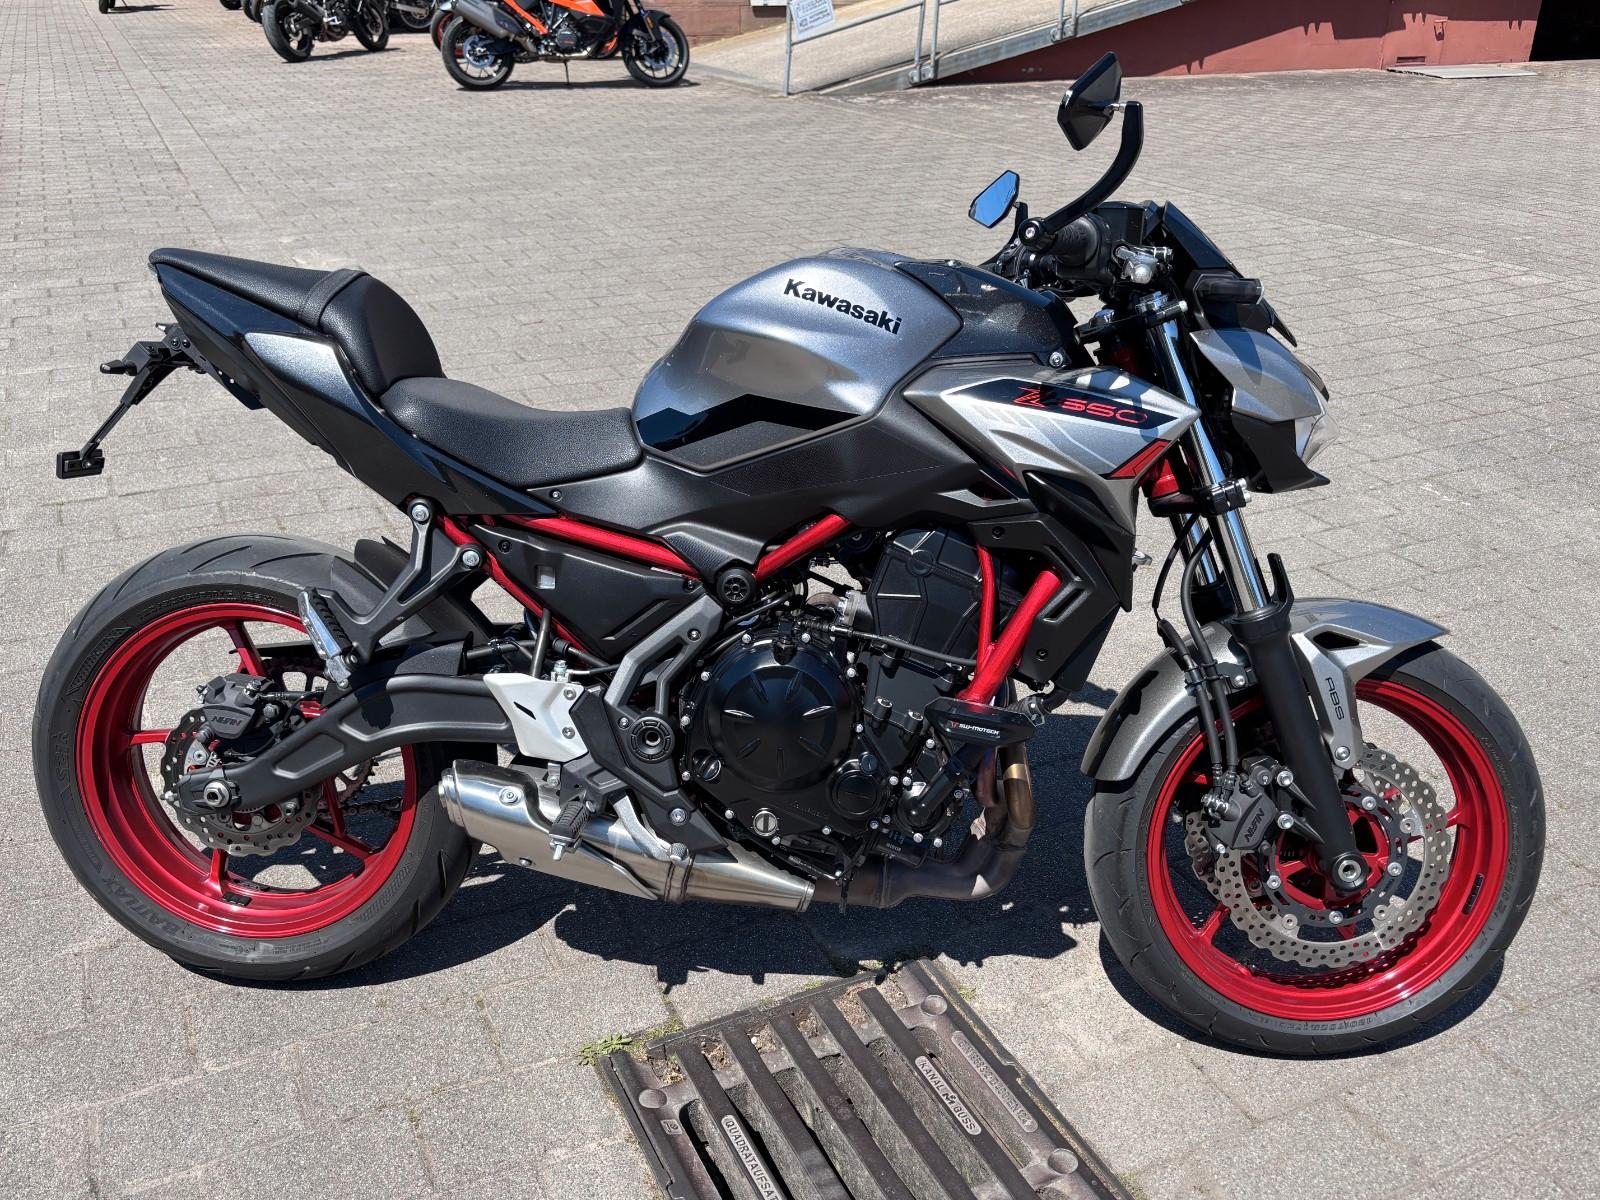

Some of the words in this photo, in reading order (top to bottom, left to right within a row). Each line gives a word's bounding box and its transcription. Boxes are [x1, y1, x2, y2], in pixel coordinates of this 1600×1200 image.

[783, 278, 903, 336] Kawasaki
[1325, 676, 1345, 721] ABS
[958, 722, 1000, 736] SW-MOTECH
[919, 1061, 945, 1090] KANAL
[952, 1104, 977, 1131] GUSS
